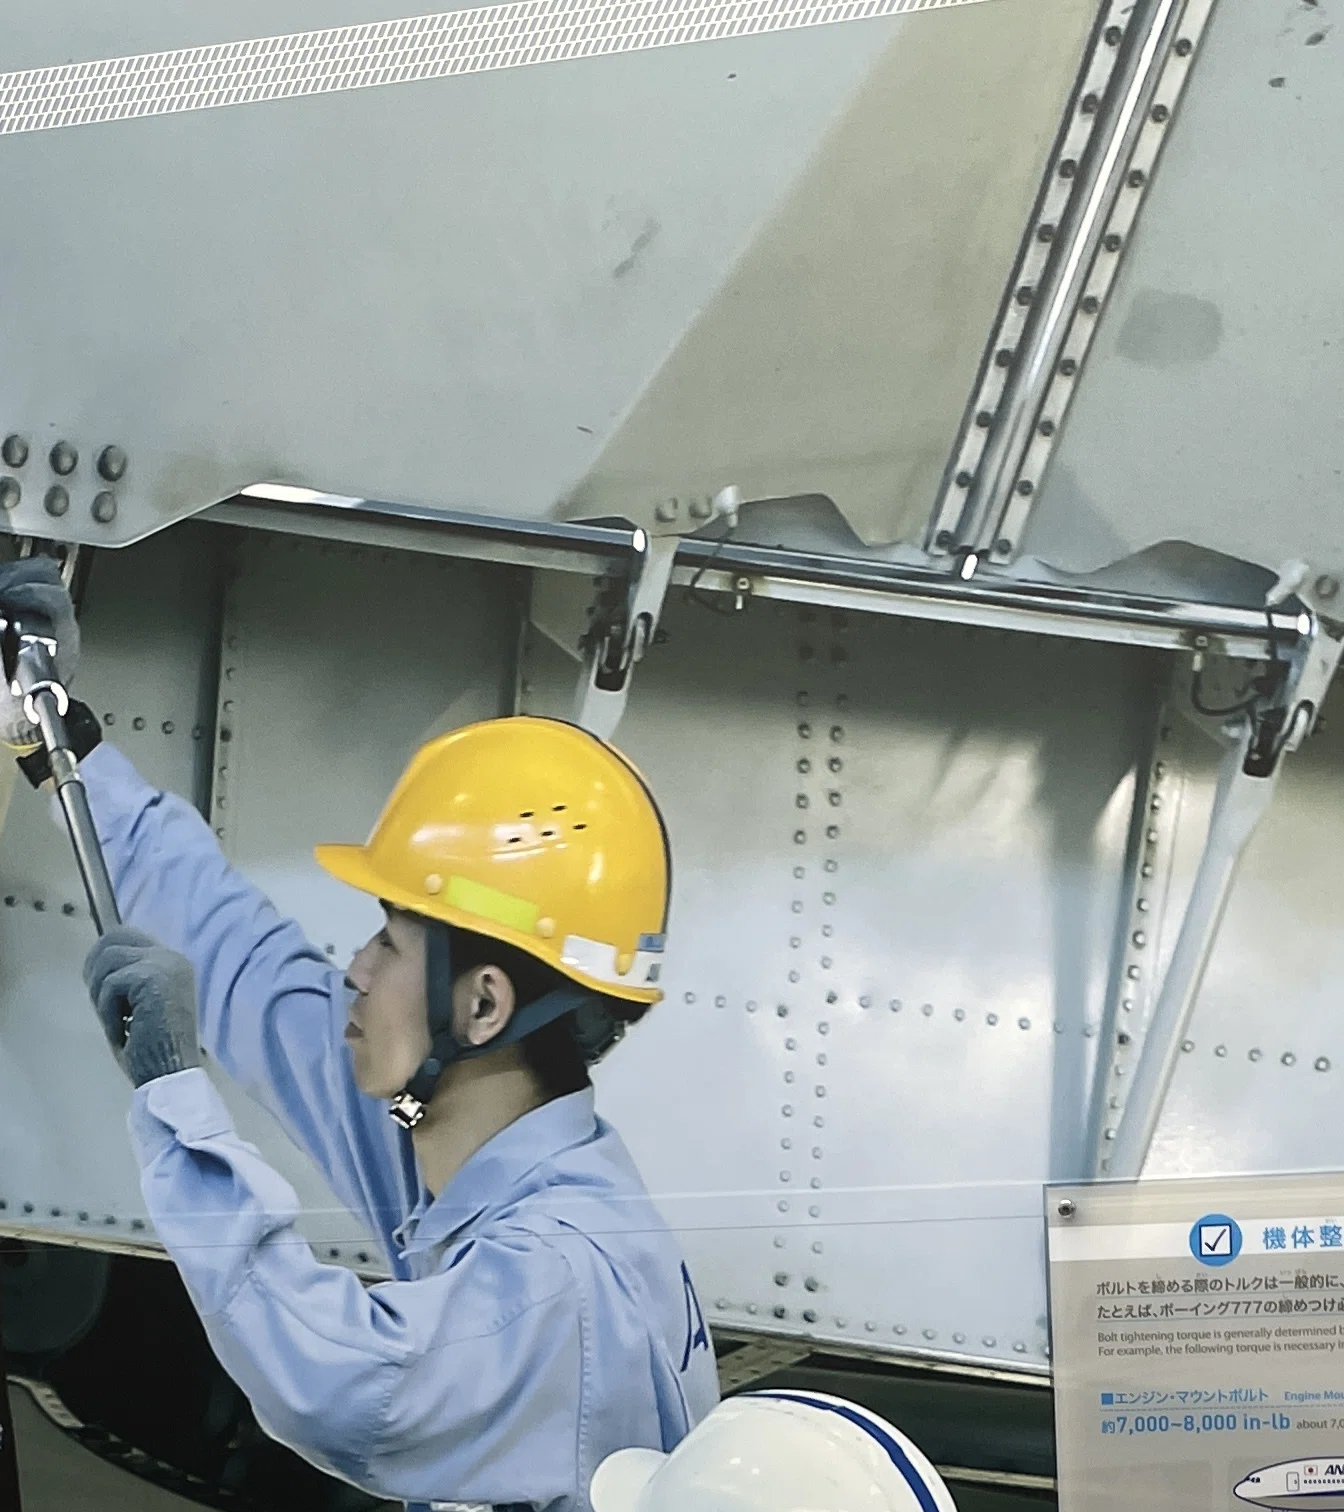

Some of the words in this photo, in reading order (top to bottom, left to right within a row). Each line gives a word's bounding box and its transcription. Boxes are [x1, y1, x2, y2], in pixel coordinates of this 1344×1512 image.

[1098, 1331, 1118, 1342] Bolt
[1120, 1329, 1174, 1344] tightening
[1176, 1328, 1211, 1343] torque
[1213, 1328, 1222, 1339] is
[1224, 1327, 1272, 1341] generally
[1275, 1325, 1336, 1337] determined
[1098, 1345, 1115, 1356] For
[1117, 1344, 1163, 1358] example,
[1165, 1343, 1182, 1355] the
[1184, 1342, 1234, 1357] following
[1235, 1341, 1271, 1355] torque
[1273, 1341, 1281, 1352] is
[1284, 1342, 1335, 1354] necessary
[1284, 1390, 1322, 1403] Engine
[1243, 1413, 1290, 1430] in-lb
[1296, 1419, 1328, 1430] about
